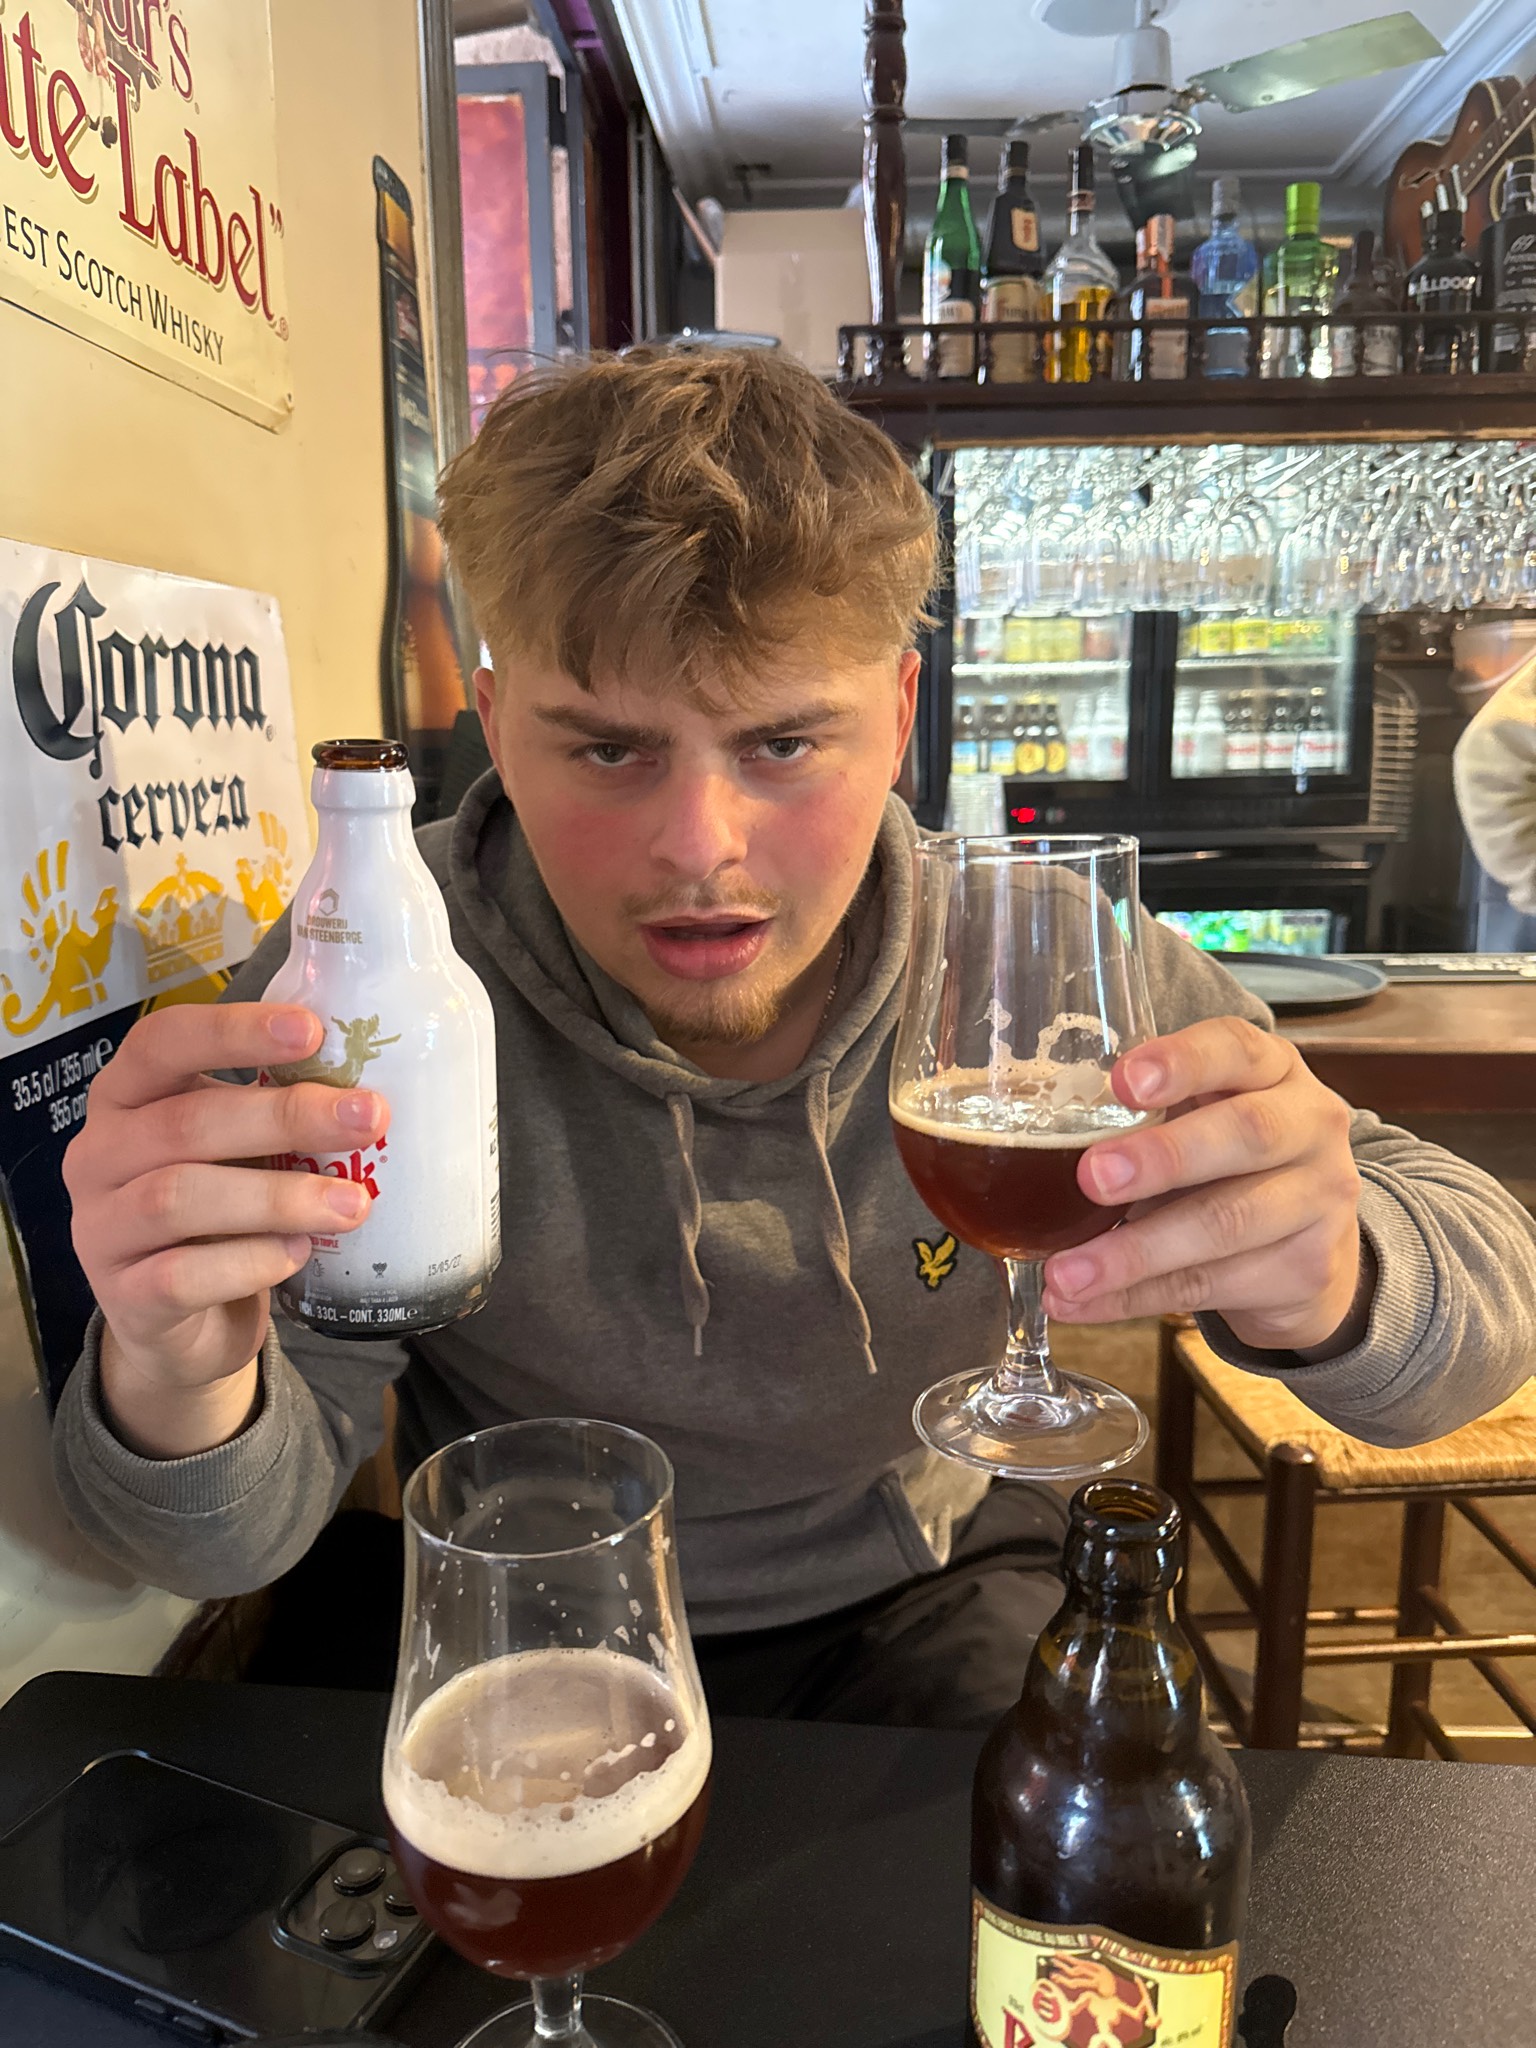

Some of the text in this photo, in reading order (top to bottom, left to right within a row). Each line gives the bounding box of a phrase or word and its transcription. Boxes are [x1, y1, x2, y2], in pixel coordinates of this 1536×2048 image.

[13, 578, 267, 780] Corona
[98, 775, 251, 853] cerveza
[12, 1070, 42, 1111] 35.5
[61, 1052, 82, 1088] 355
[48, 1096, 72, 1133] 355
[316, 1305, 339, 1321] 33CL
[349, 1308, 375, 1324] CONT.
